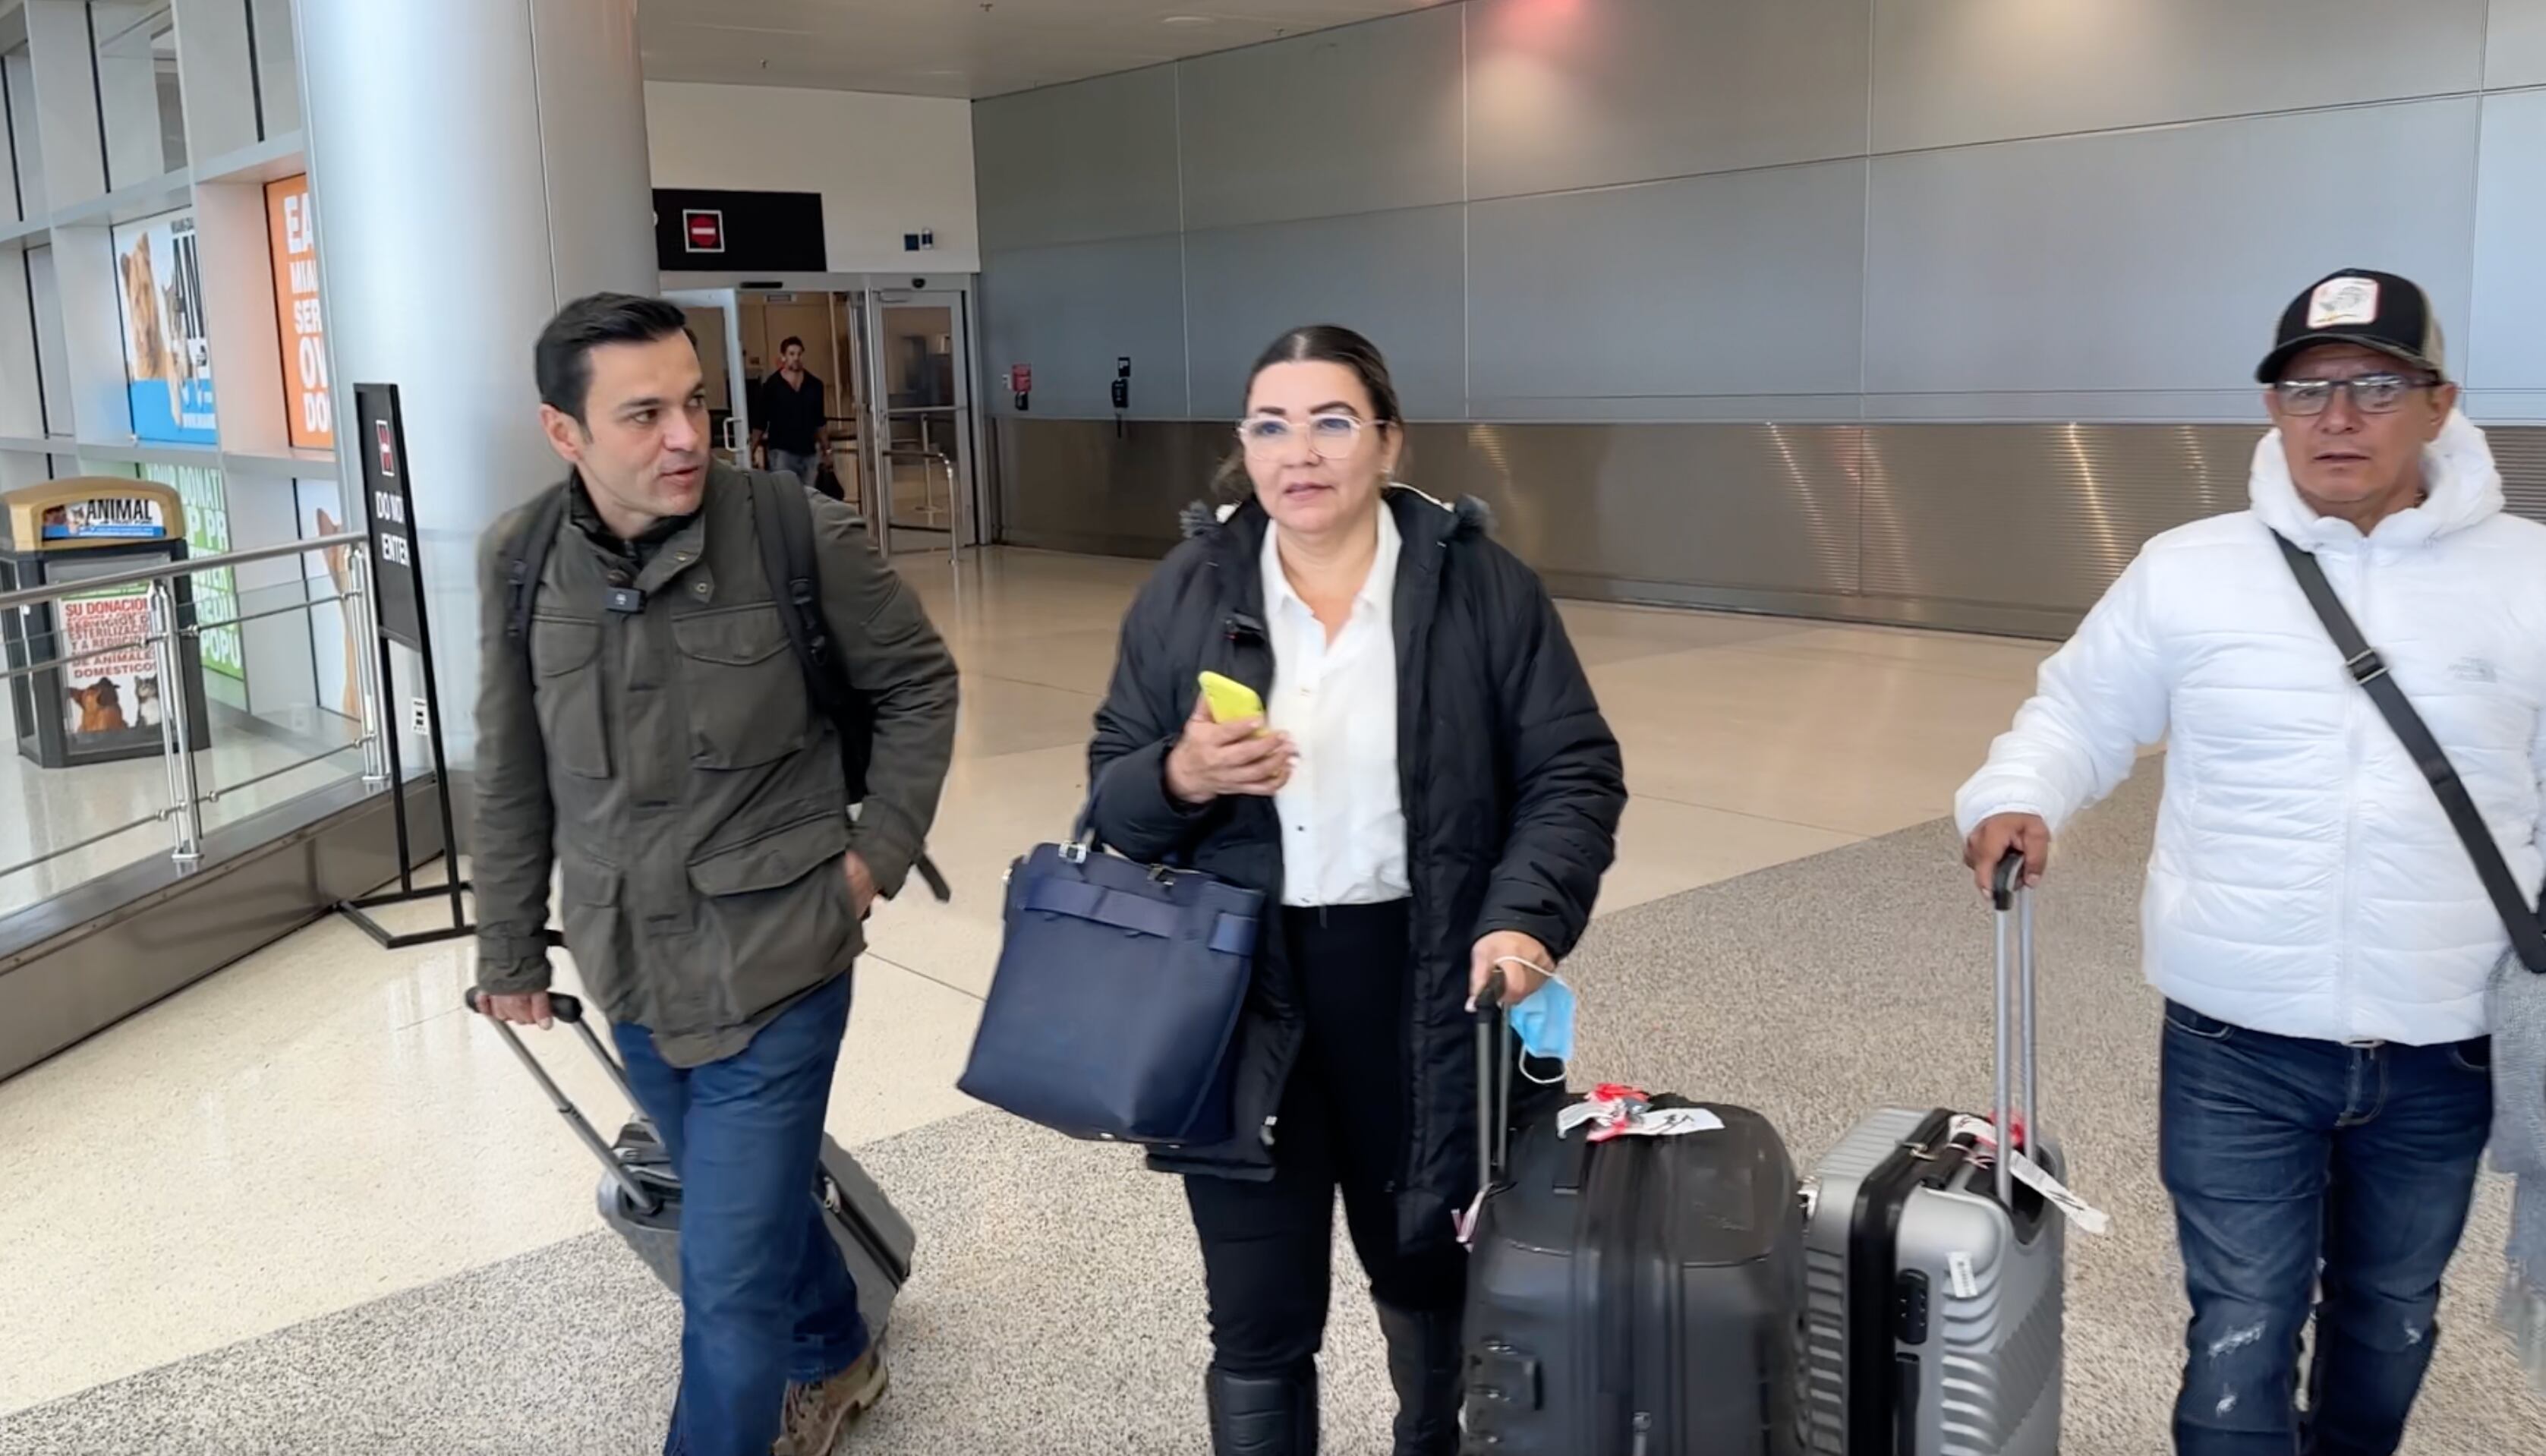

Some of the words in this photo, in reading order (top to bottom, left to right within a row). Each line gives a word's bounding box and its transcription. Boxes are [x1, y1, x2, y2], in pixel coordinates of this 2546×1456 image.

[86, 498, 153, 524] ANIMAL
[375, 490, 390, 521] DO
[65, 603, 83, 616] SU
